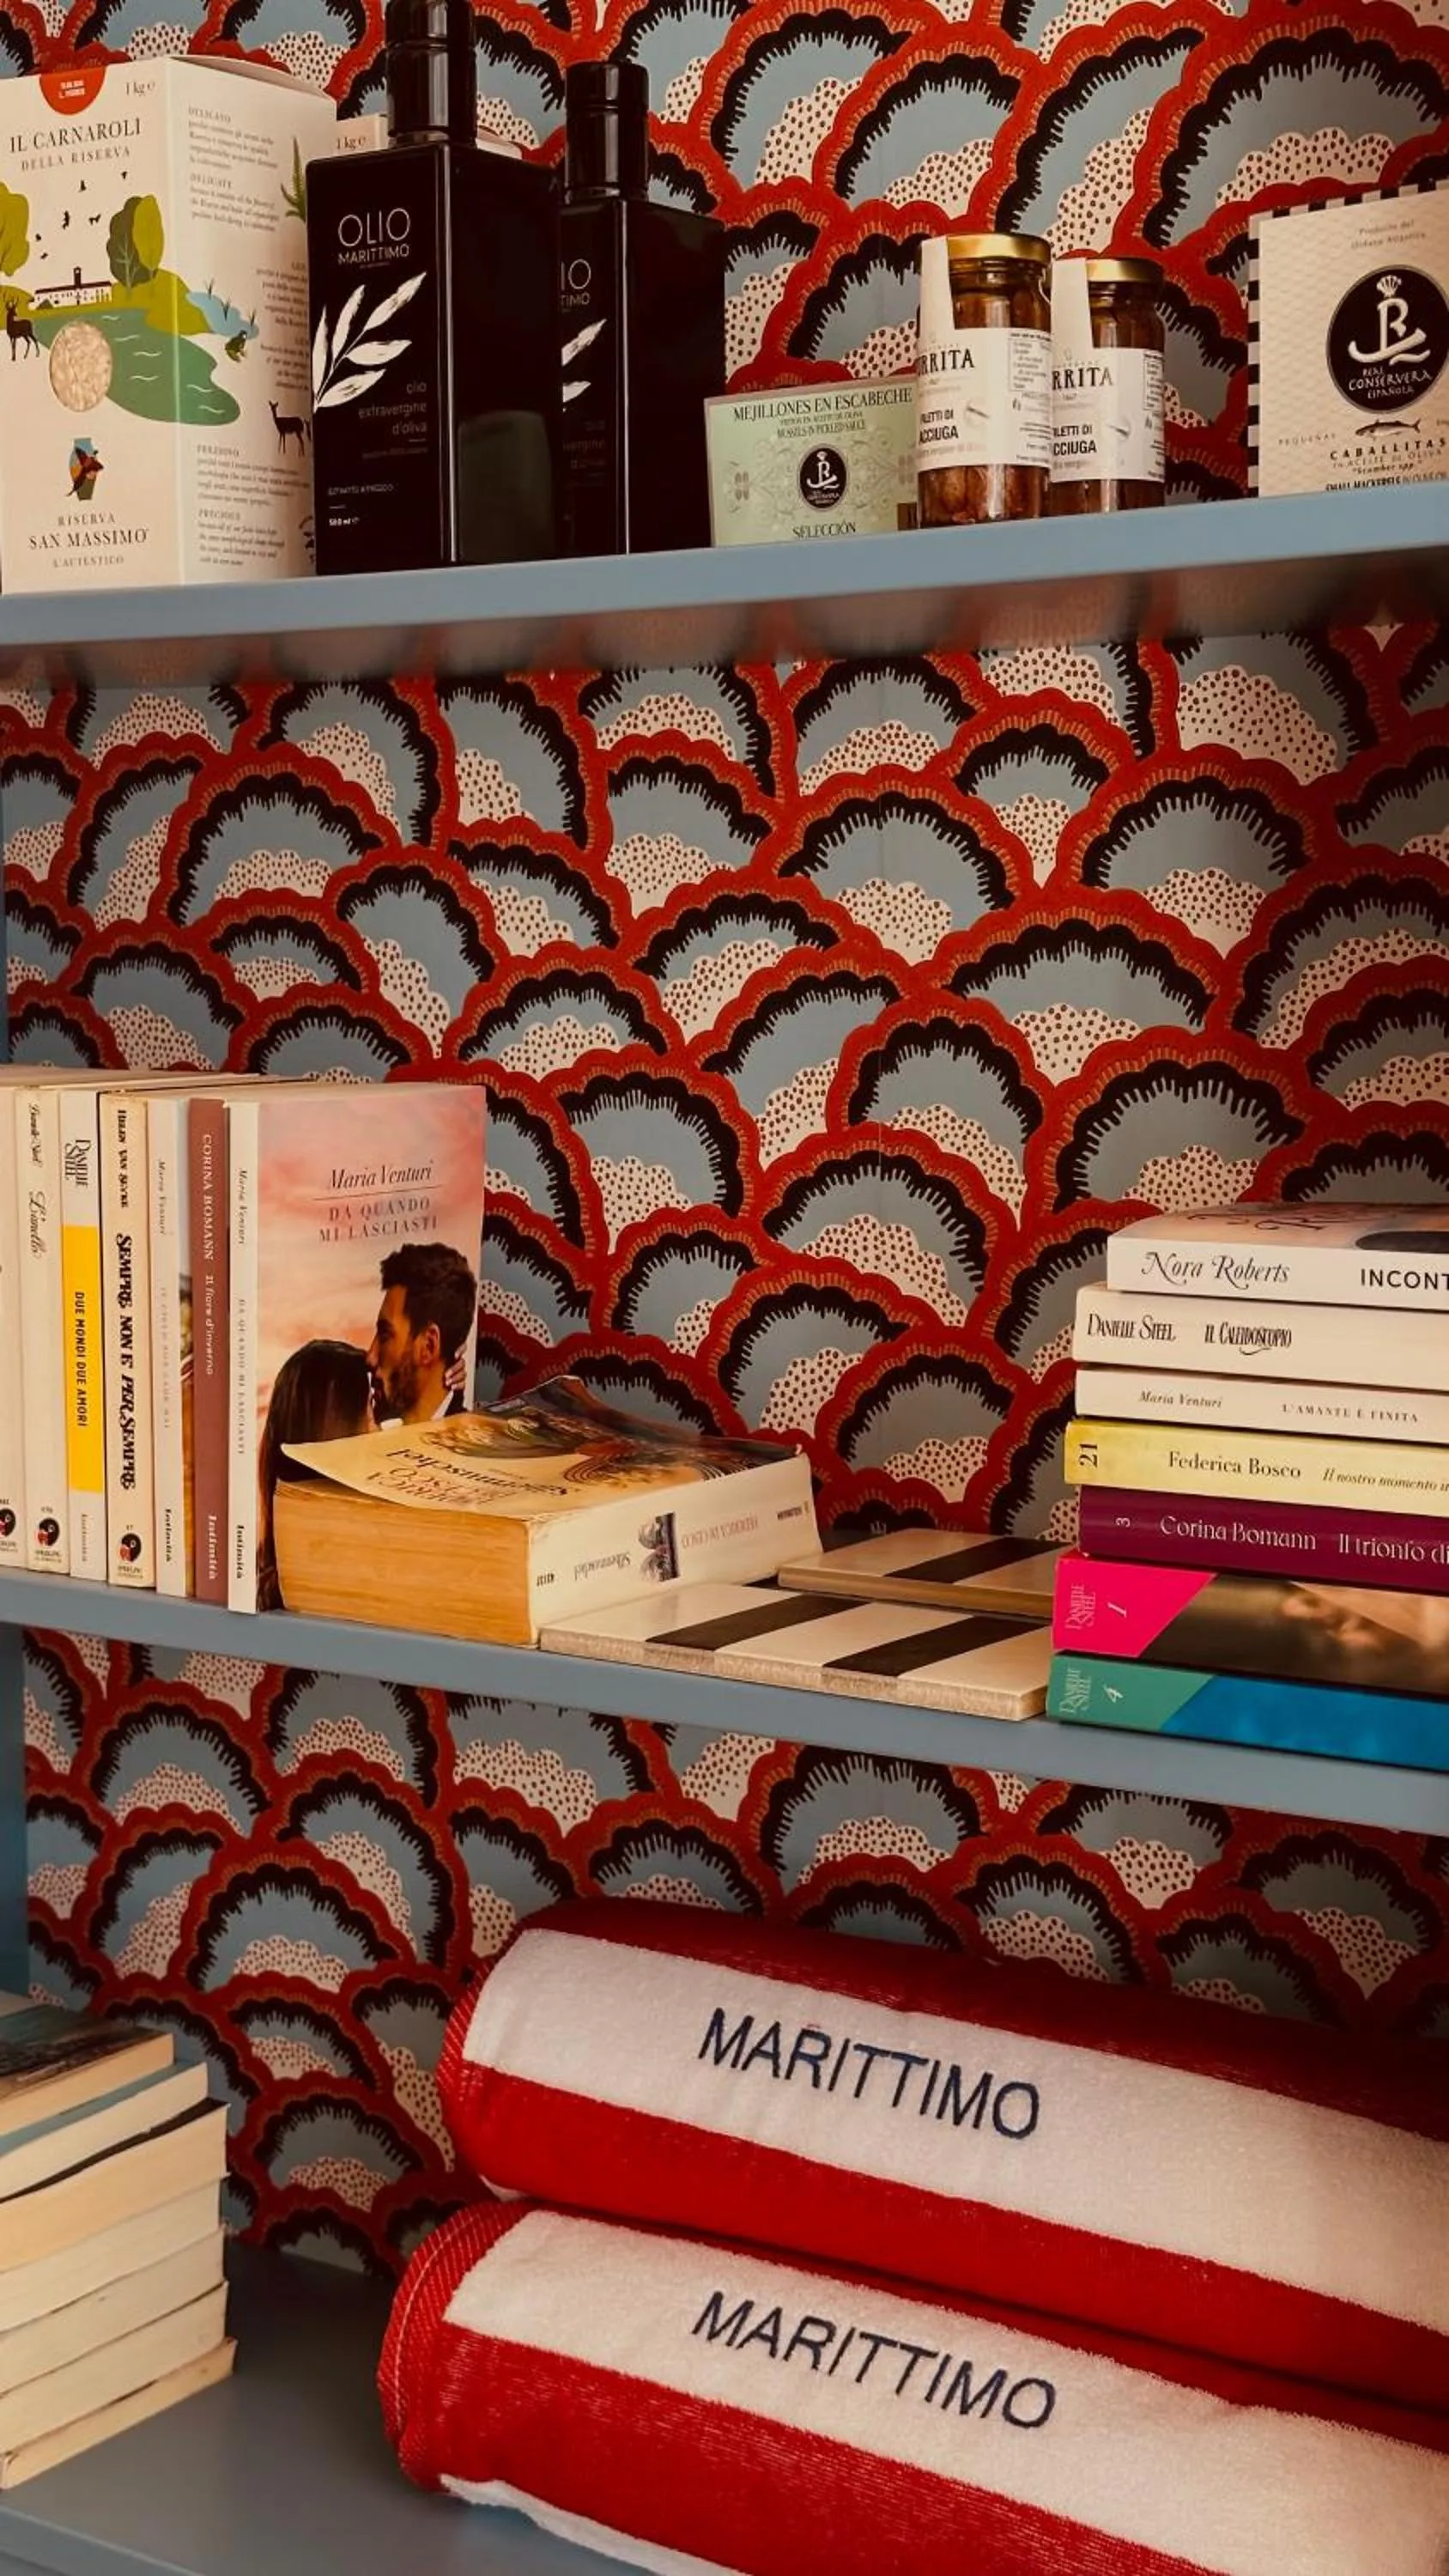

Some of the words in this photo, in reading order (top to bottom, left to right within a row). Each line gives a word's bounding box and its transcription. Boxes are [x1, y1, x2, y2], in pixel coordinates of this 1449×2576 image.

[9, 135, 27, 153] IL
[33, 118, 141, 149] CARNAROLI
[21, 155, 64, 171] DELLA
[71, 146, 130, 163] RISERVA
[338, 208, 410, 247] OLIO
[337, 244, 410, 265] MARITTIMO
[561, 258, 591, 289] IO
[406, 380, 427, 396] olio
[1349, 369, 1433, 391] CONSERVERA
[1362, 366, 1384, 377] REAL
[359, 403, 427, 419] extravergine
[733, 400, 811, 422] MEJILLONES
[815, 398, 833, 413] EN
[835, 387, 913, 410] ESCABECHE
[392, 421, 427, 435] d'oliva
[1053, 439, 1098, 456] CCIUGA
[1331, 437, 1446, 460] CABALLITAS
[58, 513, 116, 526] RISERVA
[791, 519, 856, 538] SELECCIÓN
[27, 533, 61, 550] SAN
[68, 528, 149, 547] MASSIMO
[118, 1109, 128, 1143] HELEN
[64, 1143, 77, 1181] STEEL
[75, 1139, 93, 1188] DANIELLE
[118, 1150, 128, 1170] VAN
[203, 1133, 213, 1191] CORINA
[329, 1167, 375, 1190] Maria
[379, 1160, 434, 1185] Venturi
[238, 1168, 247, 1201] Maria
[237, 1204, 247, 1245] Venturi
[329, 1206, 352, 1222] DA
[361, 1198, 431, 1220] QUANDO
[203, 1195, 214, 1261] BOMANN
[318, 1228, 341, 1242] MI
[348, 1217, 438, 1240] LASCIASTI
[116, 1233, 133, 1308] SEMPRE
[1141, 1251, 1203, 1285] Nora
[1211, 1255, 1290, 1289] Roberts
[75, 1291, 86, 1313] DUE
[204, 1287, 215, 1316] fiore
[76, 1317, 86, 1359] MONDI
[119, 1315, 133, 1352] NON
[1087, 1313, 1135, 1338] DANIELLE
[1138, 1315, 1176, 1341] STEEL
[1203, 1325, 1216, 1345] IL
[205, 1318, 215, 1375] d'inverno
[76, 1361, 87, 1386] DUE
[76, 1388, 88, 1426] AMORI
[121, 1375, 134, 1415] PER
[1138, 1390, 1174, 1406] Maria
[1179, 1394, 1222, 1409] Venturi
[1282, 1403, 1352, 1419] L'AMANTE
[1370, 1410, 1419, 1423] FINITA
[119, 1411, 136, 1490] SEMPRE
[1079, 1443, 1098, 1467] 21
[1169, 1450, 1242, 1475] Federica
[1248, 1456, 1301, 1479] Bosco
[1323, 1467, 1336, 1481] Il
[1337, 1473, 1376, 1485] nostro
[1379, 1477, 1438, 1491] momento
[208, 1514, 218, 1580] Intimità
[236, 1525, 245, 1579] Intimità
[1116, 1517, 1131, 1528] 3
[1160, 1516, 1228, 1541] Corina
[1232, 1522, 1317, 1551] Bomann
[1338, 1533, 1349, 1554] Il
[1355, 1538, 1425, 1562] trionfo
[1431, 1543, 1449, 1565] di
[1064, 1583, 1085, 1630] DANIELLE
[1082, 1592, 1096, 1627] STEEL
[1107, 1601, 1127, 1618] 1
[1059, 1668, 1081, 1713] DANIELLE
[1076, 1675, 1091, 1710] STEEL
[1103, 1685, 1124, 1704] 4
[697, 2007, 1040, 2140] MARITTIMO
[691, 2291, 1056, 2429] MARITTIMO
